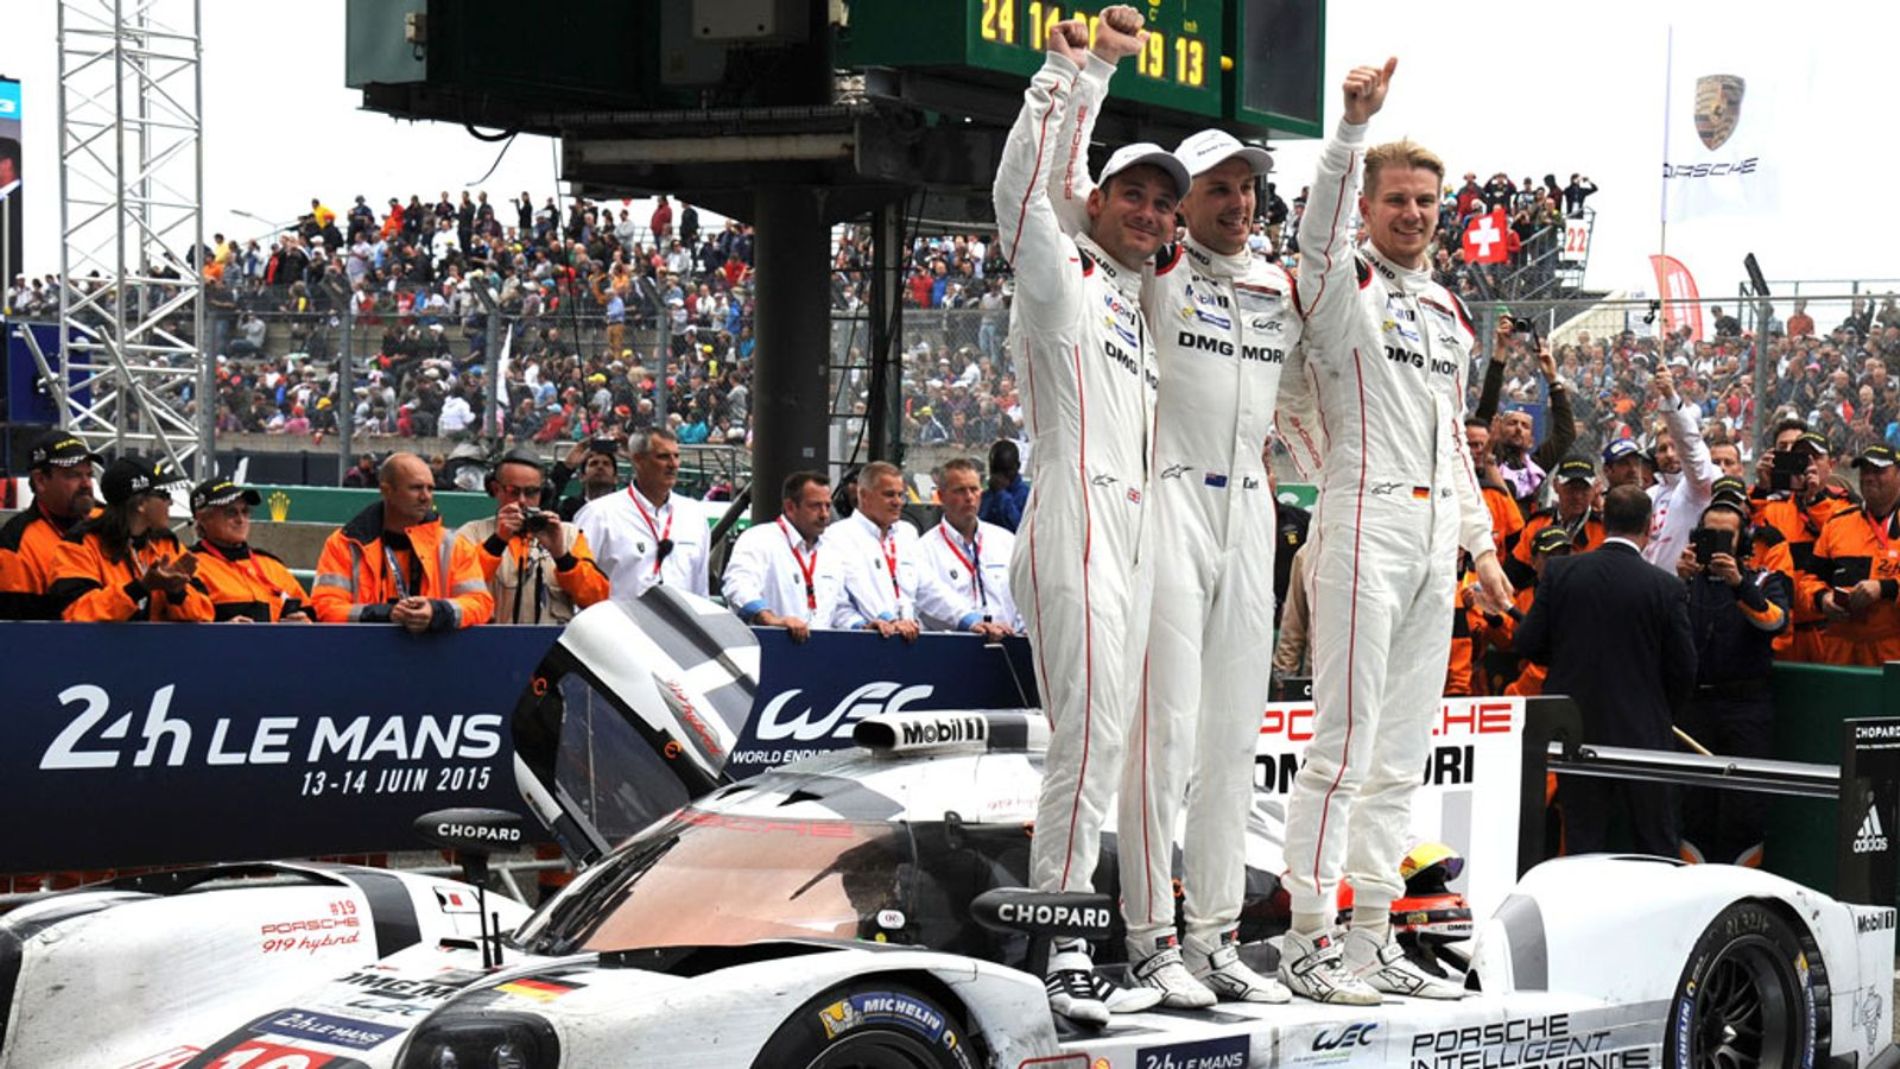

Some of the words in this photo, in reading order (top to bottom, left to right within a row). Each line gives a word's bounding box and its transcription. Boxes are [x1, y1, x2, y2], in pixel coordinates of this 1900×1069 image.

[981, 0, 1014, 44] 24
[1175, 36, 1204, 87] 13
[1566, 228, 1586, 252] 22
[1104, 340, 1138, 376] DMG
[1178, 330, 1235, 357] DMG
[1241, 344, 1281, 365] MOR
[39, 684, 192, 770] 24h
[206, 717, 299, 765] LE
[307, 714, 502, 763] MANS
[900, 718, 963, 745] Mobil
[732, 750, 781, 764] WORLD
[301, 770, 368, 796] 13-14
[375, 768, 429, 793] JUIN
[436, 767, 492, 791] 2015
[437, 823, 521, 841] CHOPARD
[1853, 834, 1888, 853] adidas
[329, 899, 358, 916] #19
[998, 903, 1111, 928] CHOPARD
[261, 916, 360, 936] PORSCHE
[1857, 911, 1884, 934] Mobil
[262, 937, 297, 954] 919
[298, 929, 360, 956] hybrid
[864, 997, 941, 1032] MICHELIN
[1312, 1022, 1378, 1051] WEC
[1411, 1013, 1569, 1057] PORSCHE
[1200, 1053, 1243, 1069] MANS
